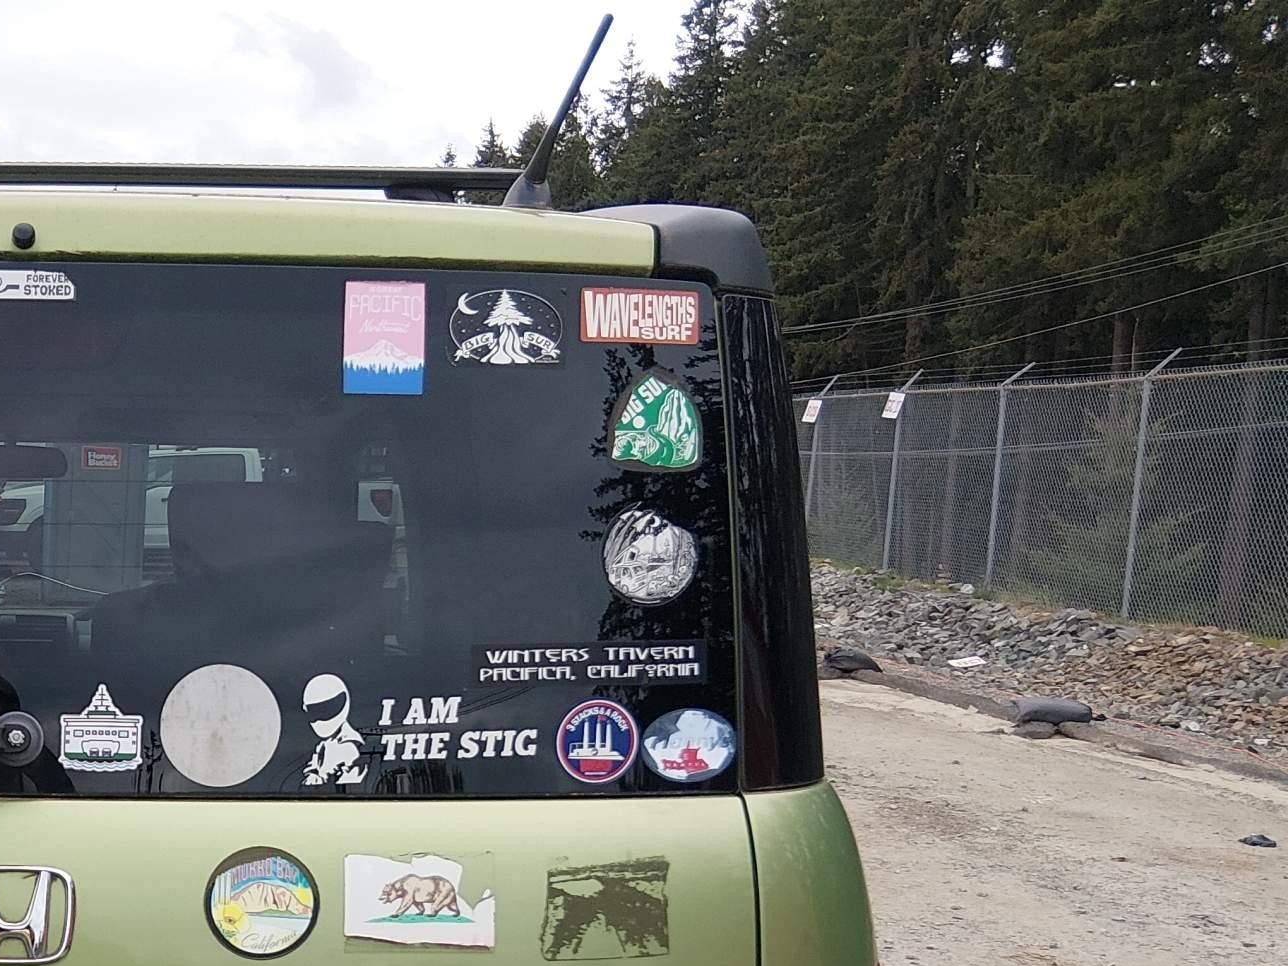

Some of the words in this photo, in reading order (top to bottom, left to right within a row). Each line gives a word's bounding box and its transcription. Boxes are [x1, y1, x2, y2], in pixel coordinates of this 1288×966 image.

[23, 285, 72, 296] STOKED
[349, 294, 422, 320] PACIFIC
[584, 290, 695, 338] WAVELENGTHS
[464, 334, 490, 351] BIG
[527, 333, 552, 351] SUR
[641, 324, 693, 340] SURF
[486, 648, 589, 664] WINTERS
[603, 646, 695, 660] TAVERN
[480, 666, 577, 681] PACIFICA,
[587, 663, 700, 678] CALIFORNIA
[378, 699, 395, 726] I
[402, 697, 462, 726] AM
[381, 733, 450, 761] THE
[457, 729, 538, 760] STIG
[241, 929, 298, 952] California
